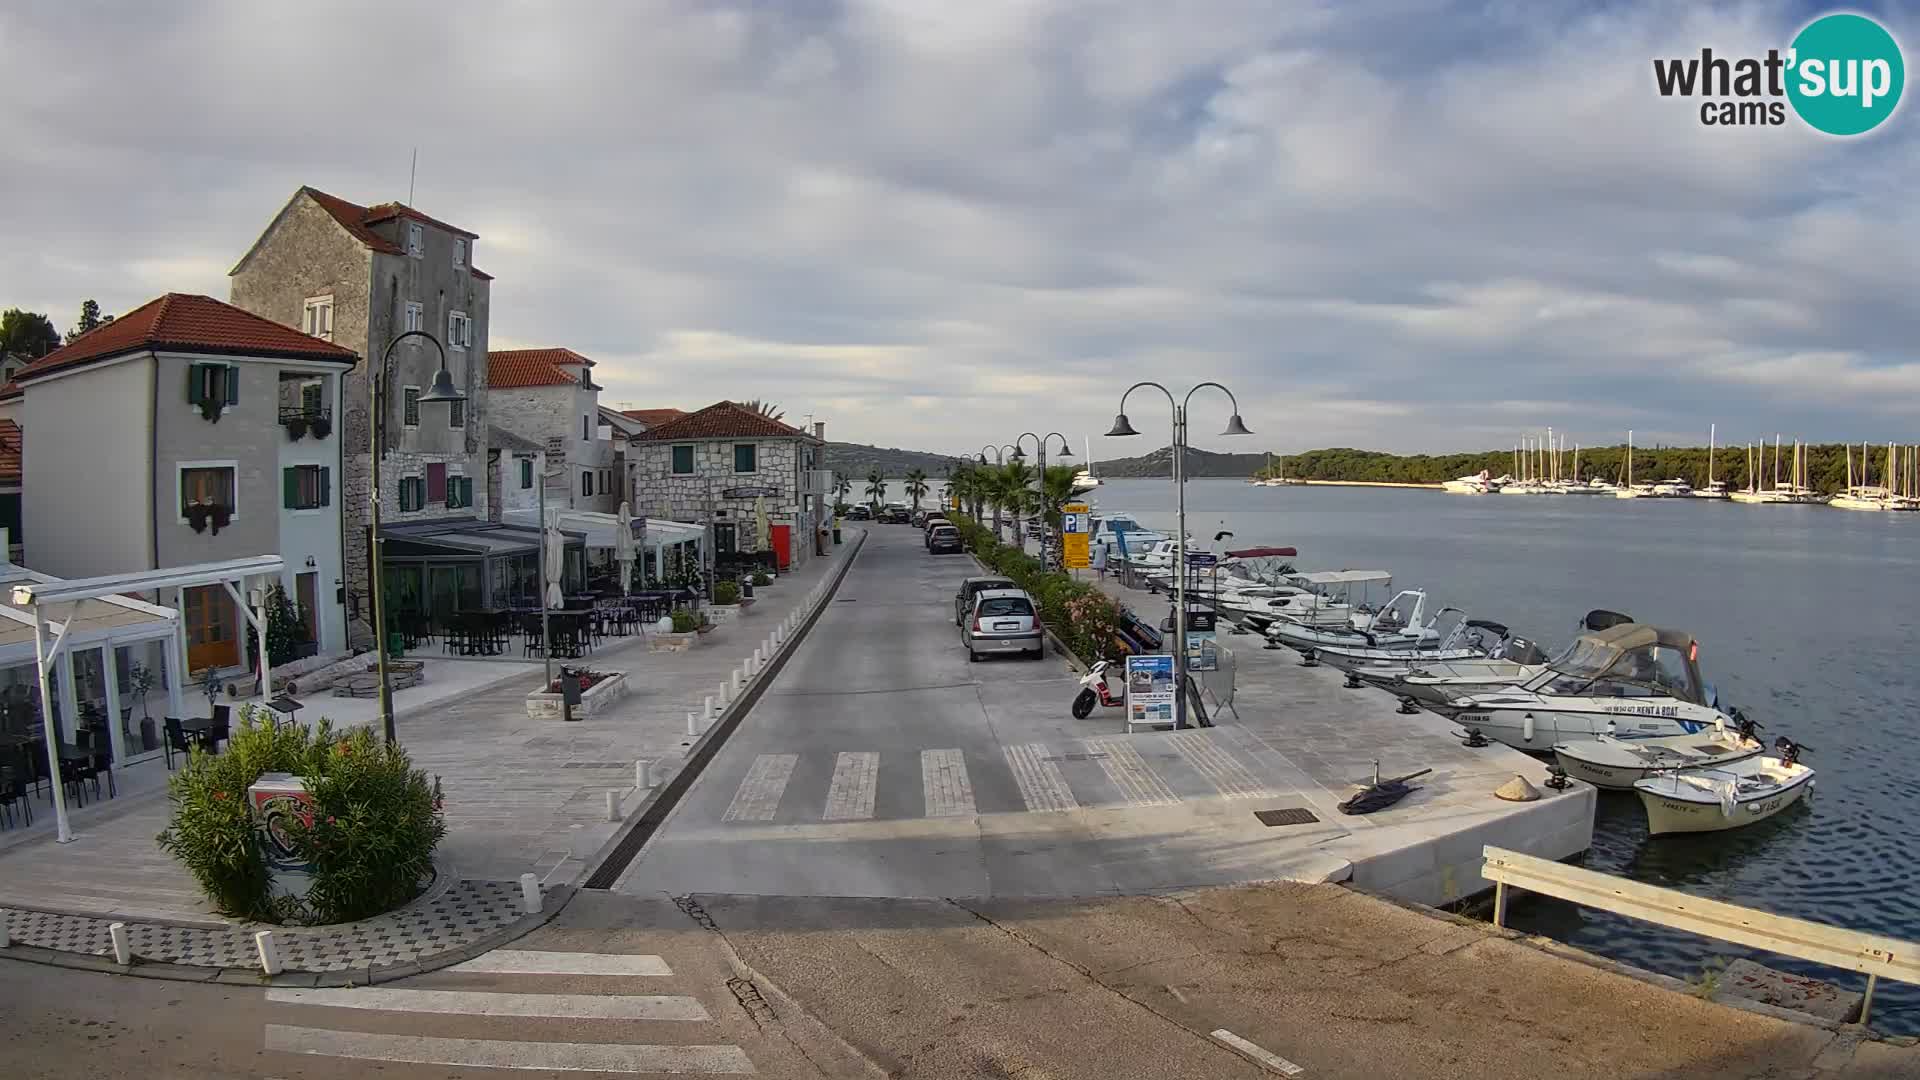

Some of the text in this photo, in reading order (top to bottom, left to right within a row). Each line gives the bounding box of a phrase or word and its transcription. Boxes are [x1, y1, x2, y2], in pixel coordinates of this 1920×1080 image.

[1065, 515, 1076, 532] P
[1636, 705, 1655, 715] RENT
[1661, 706, 1679, 717] BOAT
